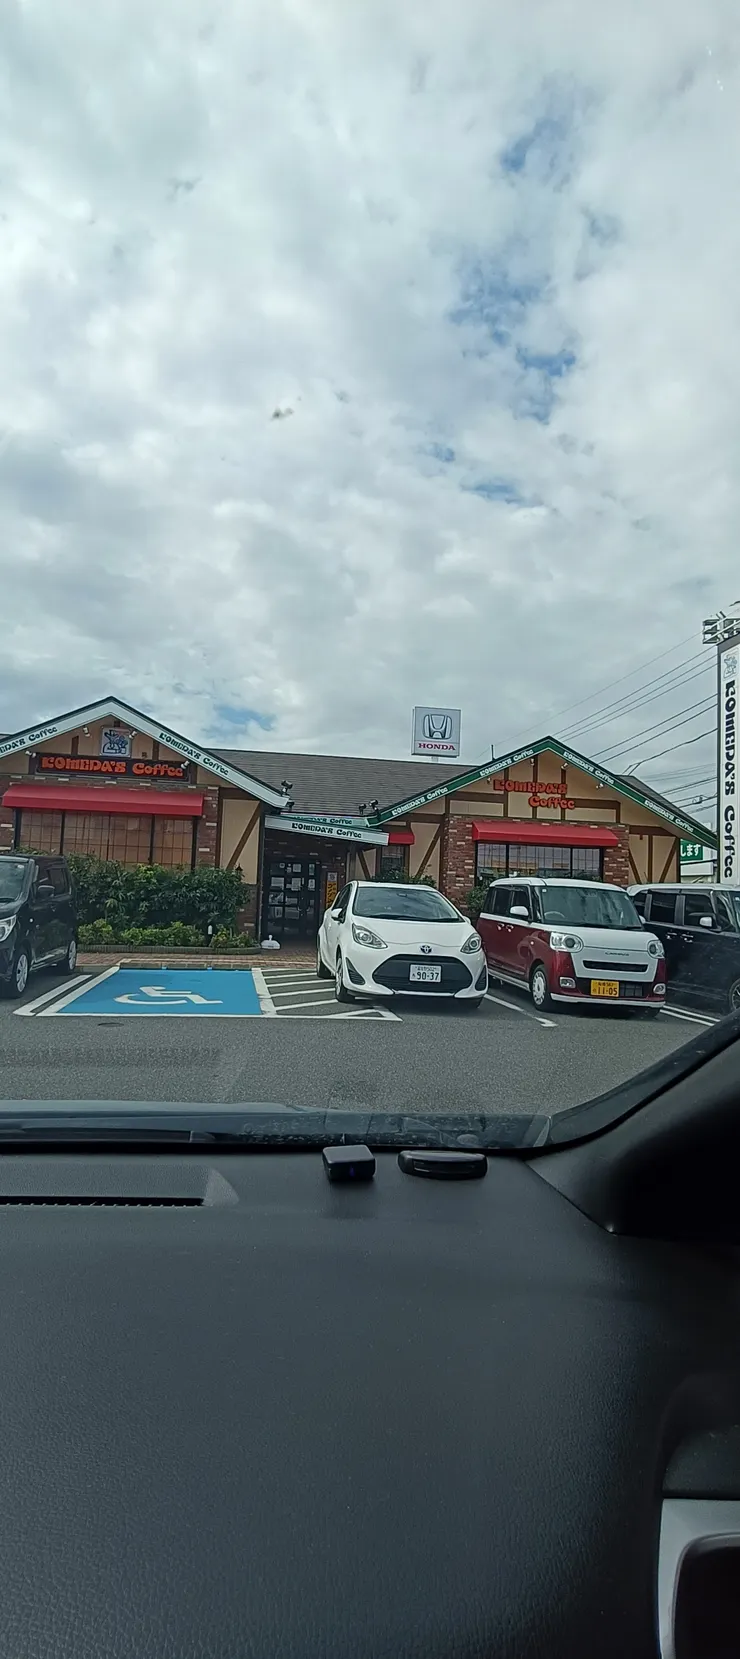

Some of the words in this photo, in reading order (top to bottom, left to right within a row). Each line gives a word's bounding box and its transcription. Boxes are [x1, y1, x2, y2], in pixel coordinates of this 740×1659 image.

[28, 726, 58, 741] Coffee
[725, 680, 736, 796] KOMEDA'S
[418, 743, 456, 751] HONDA
[41, 757, 126, 773] KOMEDA'S
[132, 762, 183, 777] Coffee
[203, 757, 229, 776] Coffee
[528, 795, 575, 809] Coffee
[336, 829, 362, 839] Coffee
[724, 805, 736, 878] Coffee
